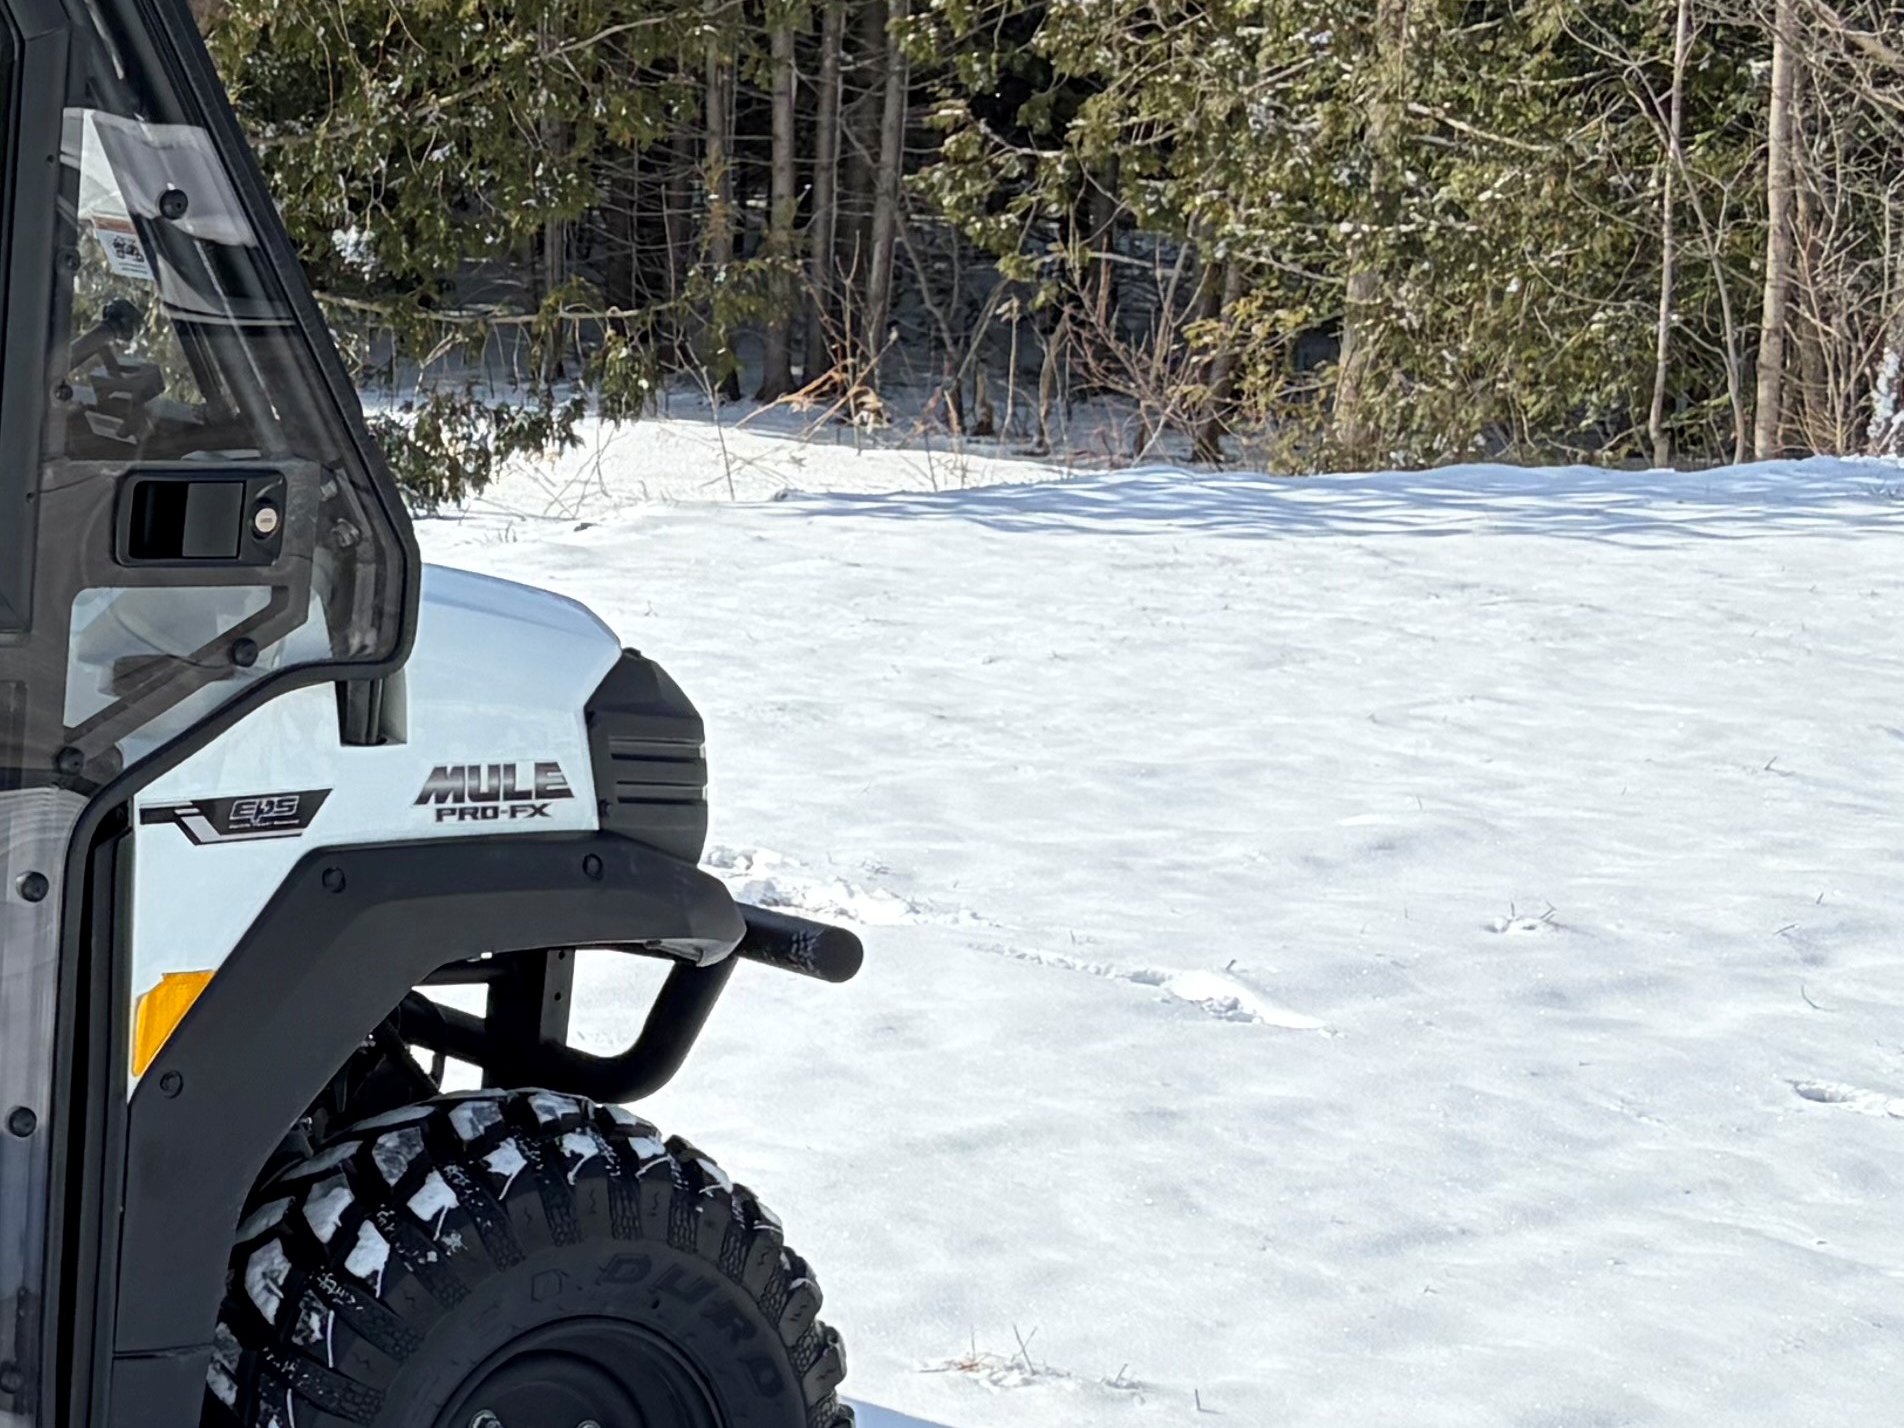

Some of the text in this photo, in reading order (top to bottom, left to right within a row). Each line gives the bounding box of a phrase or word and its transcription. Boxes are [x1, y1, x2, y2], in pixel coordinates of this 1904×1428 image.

[412, 761, 575, 805] MULE
[434, 802, 552, 823] PRO-FX
[596, 1252, 784, 1398] DURO
